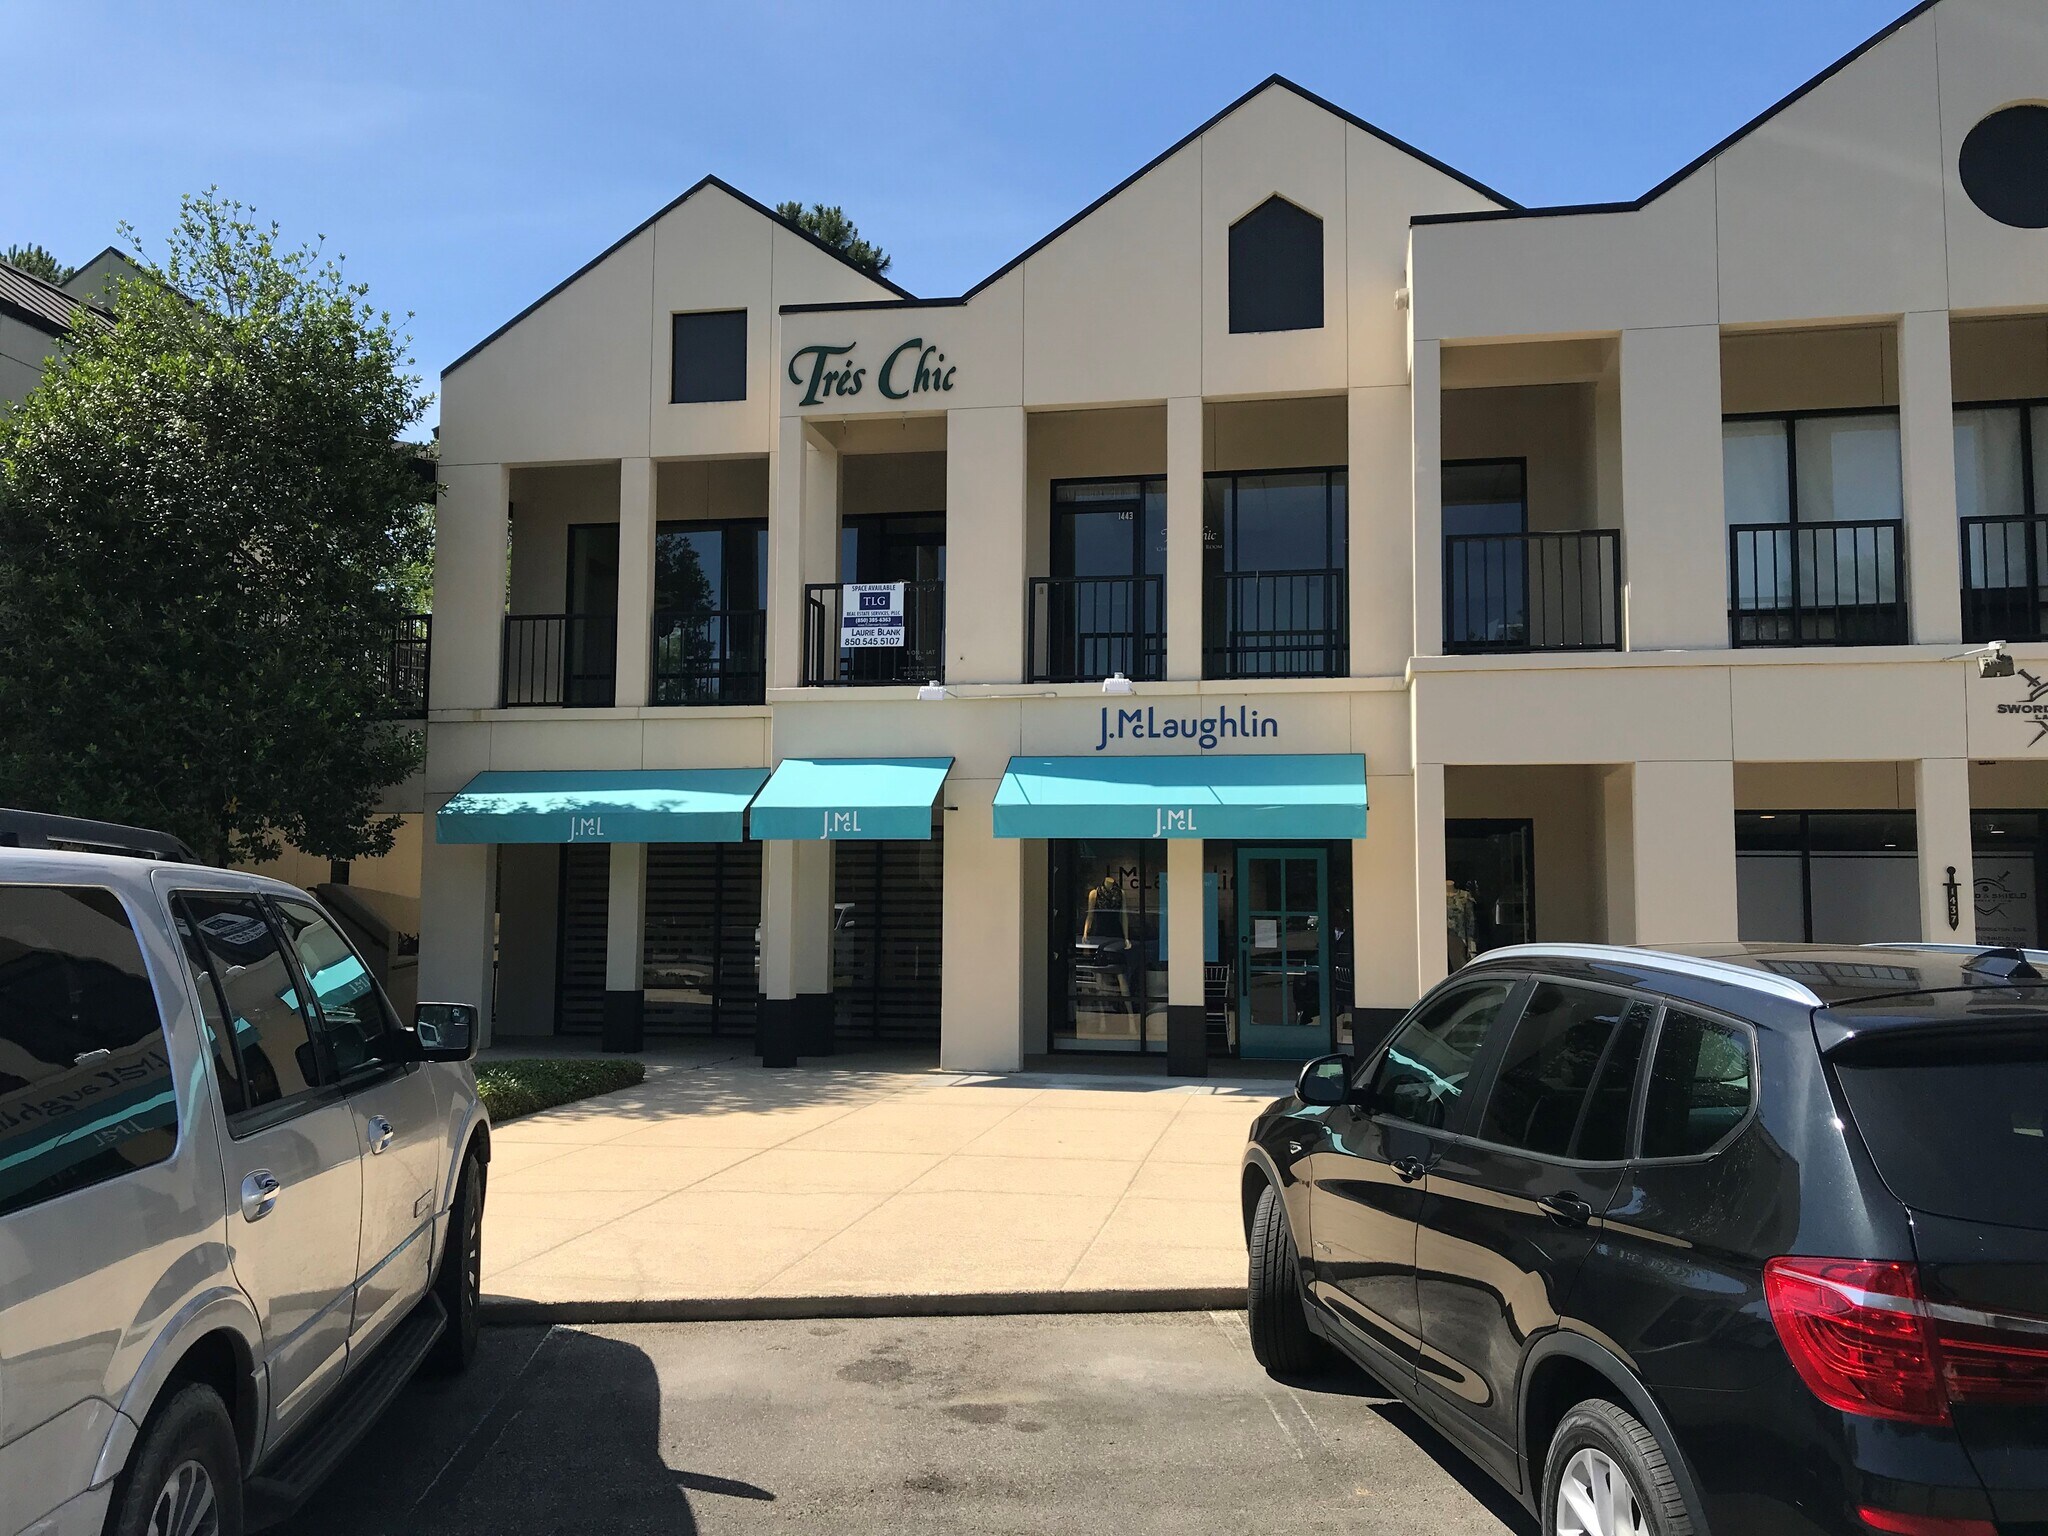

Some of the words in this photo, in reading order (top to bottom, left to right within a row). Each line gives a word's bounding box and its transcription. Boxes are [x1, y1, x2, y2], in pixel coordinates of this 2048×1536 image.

[878, 337, 957, 400] Chic
[1118, 511, 1134, 520] 1443
[863, 596, 886, 606] TLG
[844, 637, 900, 646] 850.545.5107
[851, 628, 875, 636] LAURIE
[877, 628, 901, 636] BLANK
[1095, 705, 1278, 751] J.McLaughlin
[567, 816, 605, 843] J.McL
[819, 810, 862, 840] J.McL
[1152, 807, 1197, 838] J.McL
[1949, 887, 1957, 924] 1437
